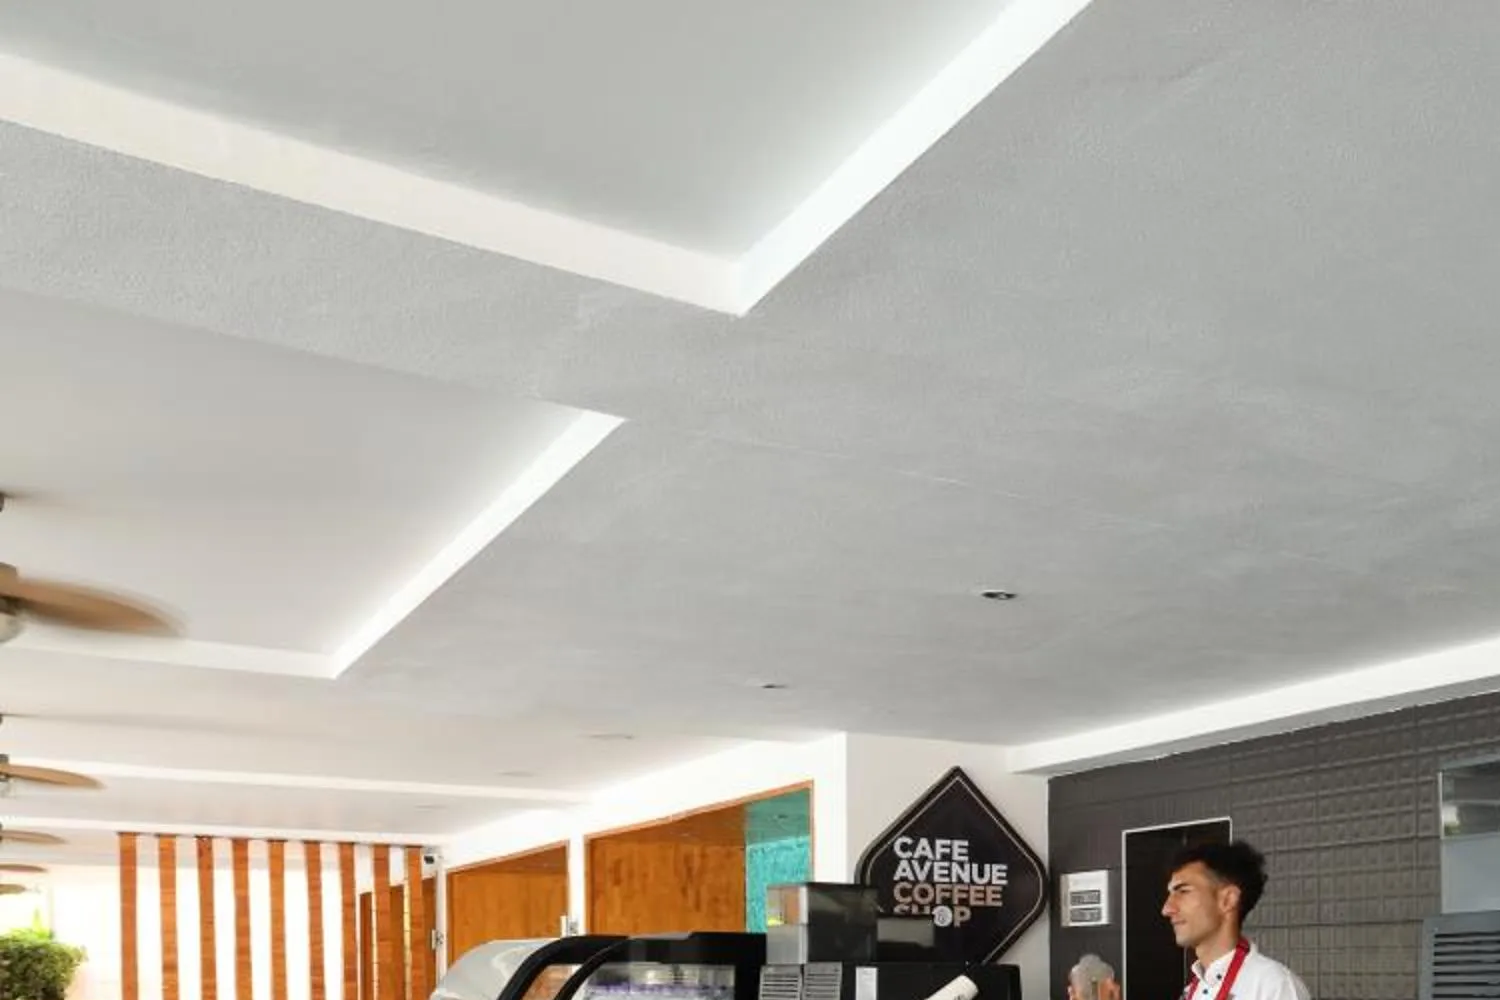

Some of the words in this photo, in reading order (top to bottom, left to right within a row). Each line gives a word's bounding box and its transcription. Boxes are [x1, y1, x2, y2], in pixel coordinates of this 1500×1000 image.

[893, 836, 970, 861] CAFE
[893, 860, 1009, 885] AVENUE
[893, 882, 1004, 907] COFFEE
